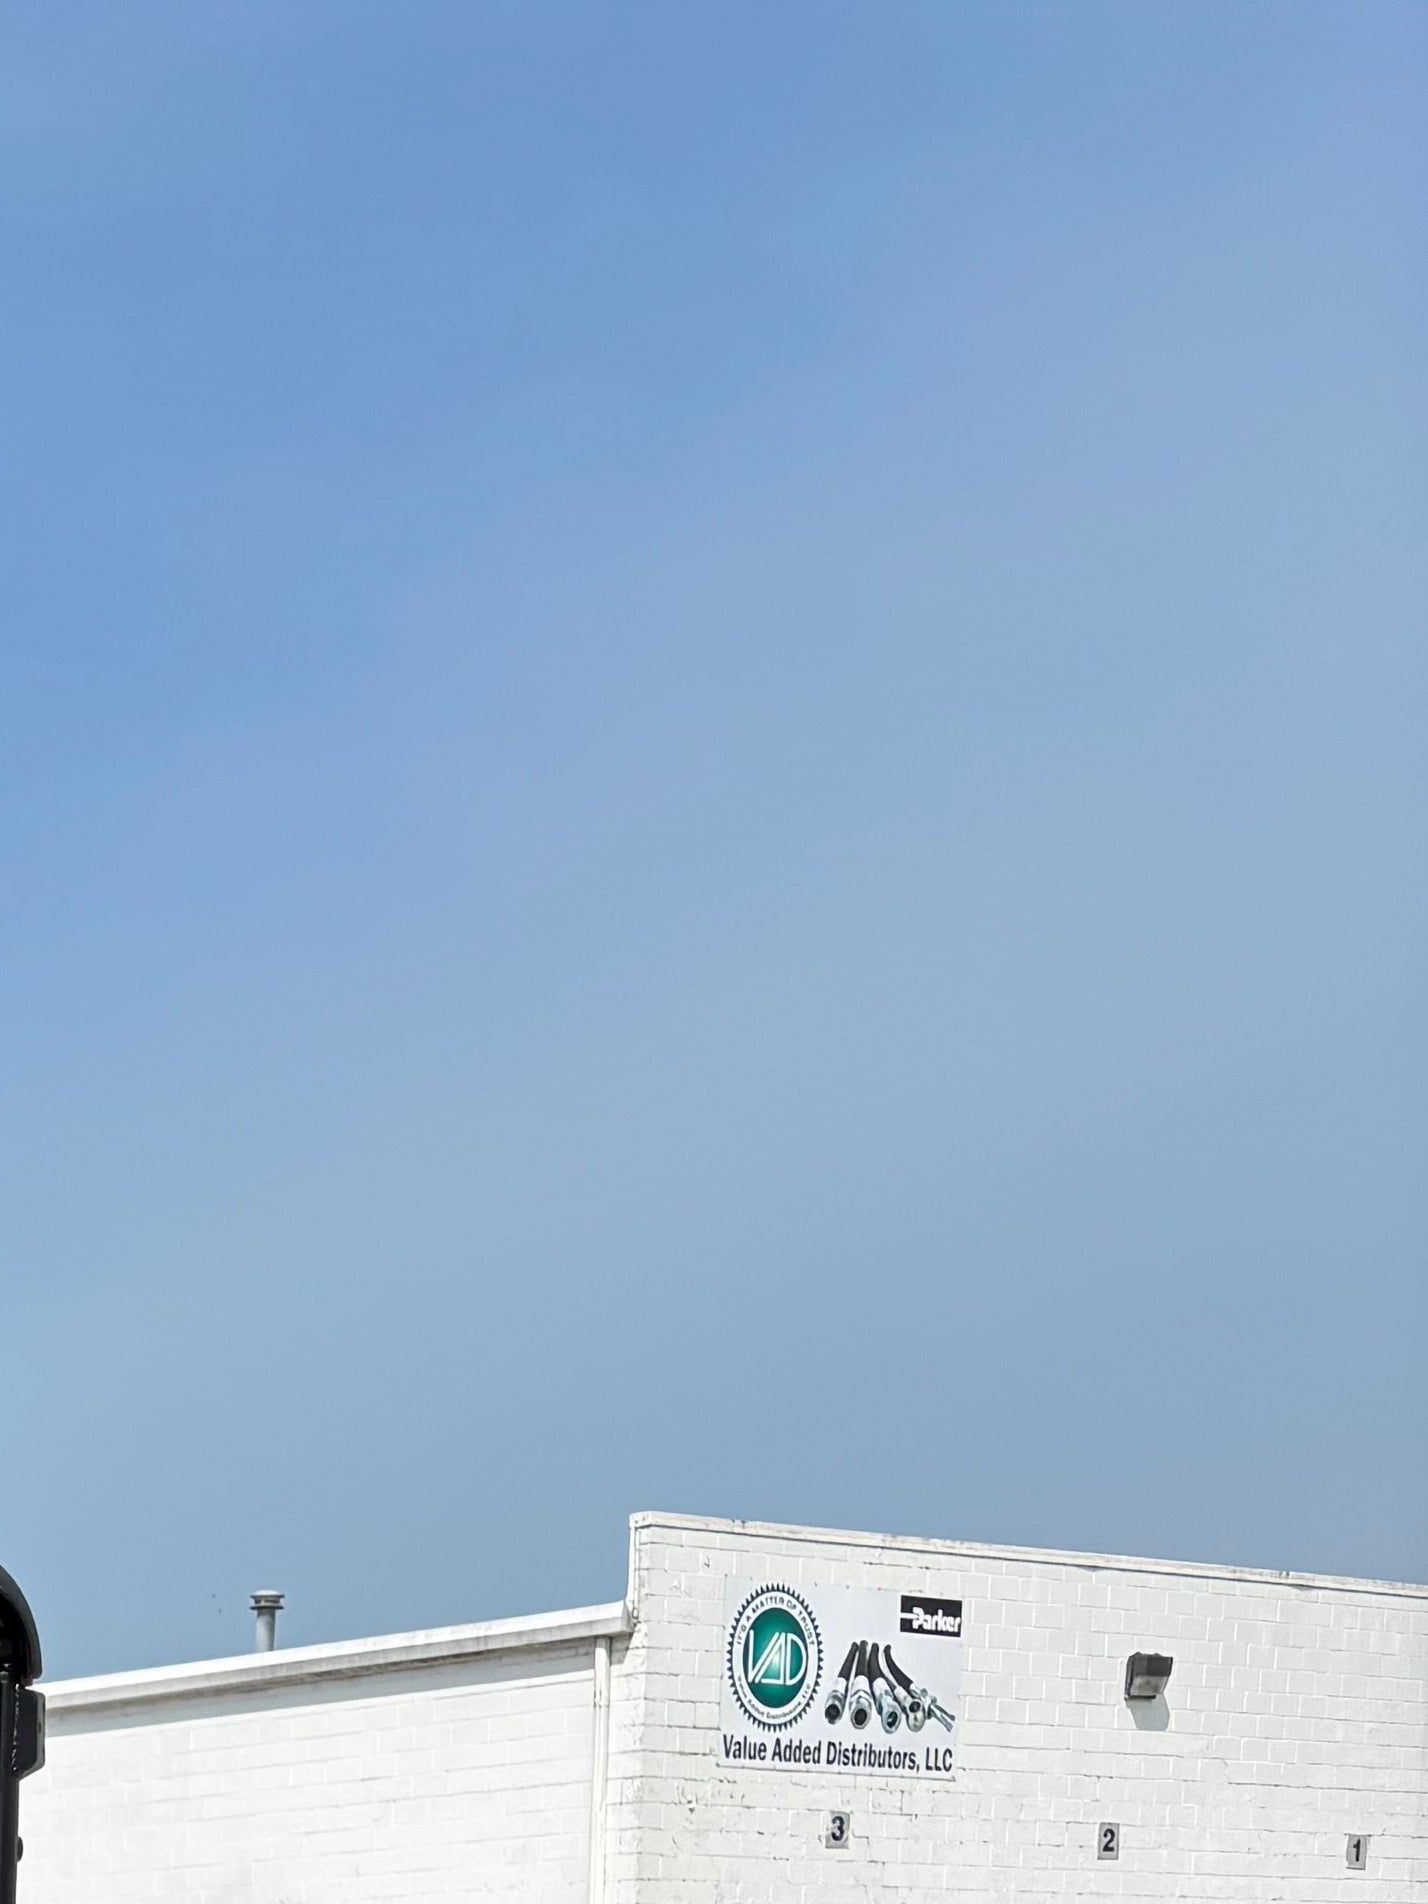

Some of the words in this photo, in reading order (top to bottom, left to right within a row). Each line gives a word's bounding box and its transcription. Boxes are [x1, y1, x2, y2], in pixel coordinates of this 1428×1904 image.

[911, 1606, 962, 1633] Parker
[723, 1733, 768, 1761] Value
[771, 1736, 822, 1765] Added
[826, 1740, 920, 1774] Distributors,
[925, 1746, 953, 1772] LLC
[831, 1815, 845, 1842] 3
[1102, 1827, 1116, 1853] 2
[1352, 1838, 1362, 1863] 1
